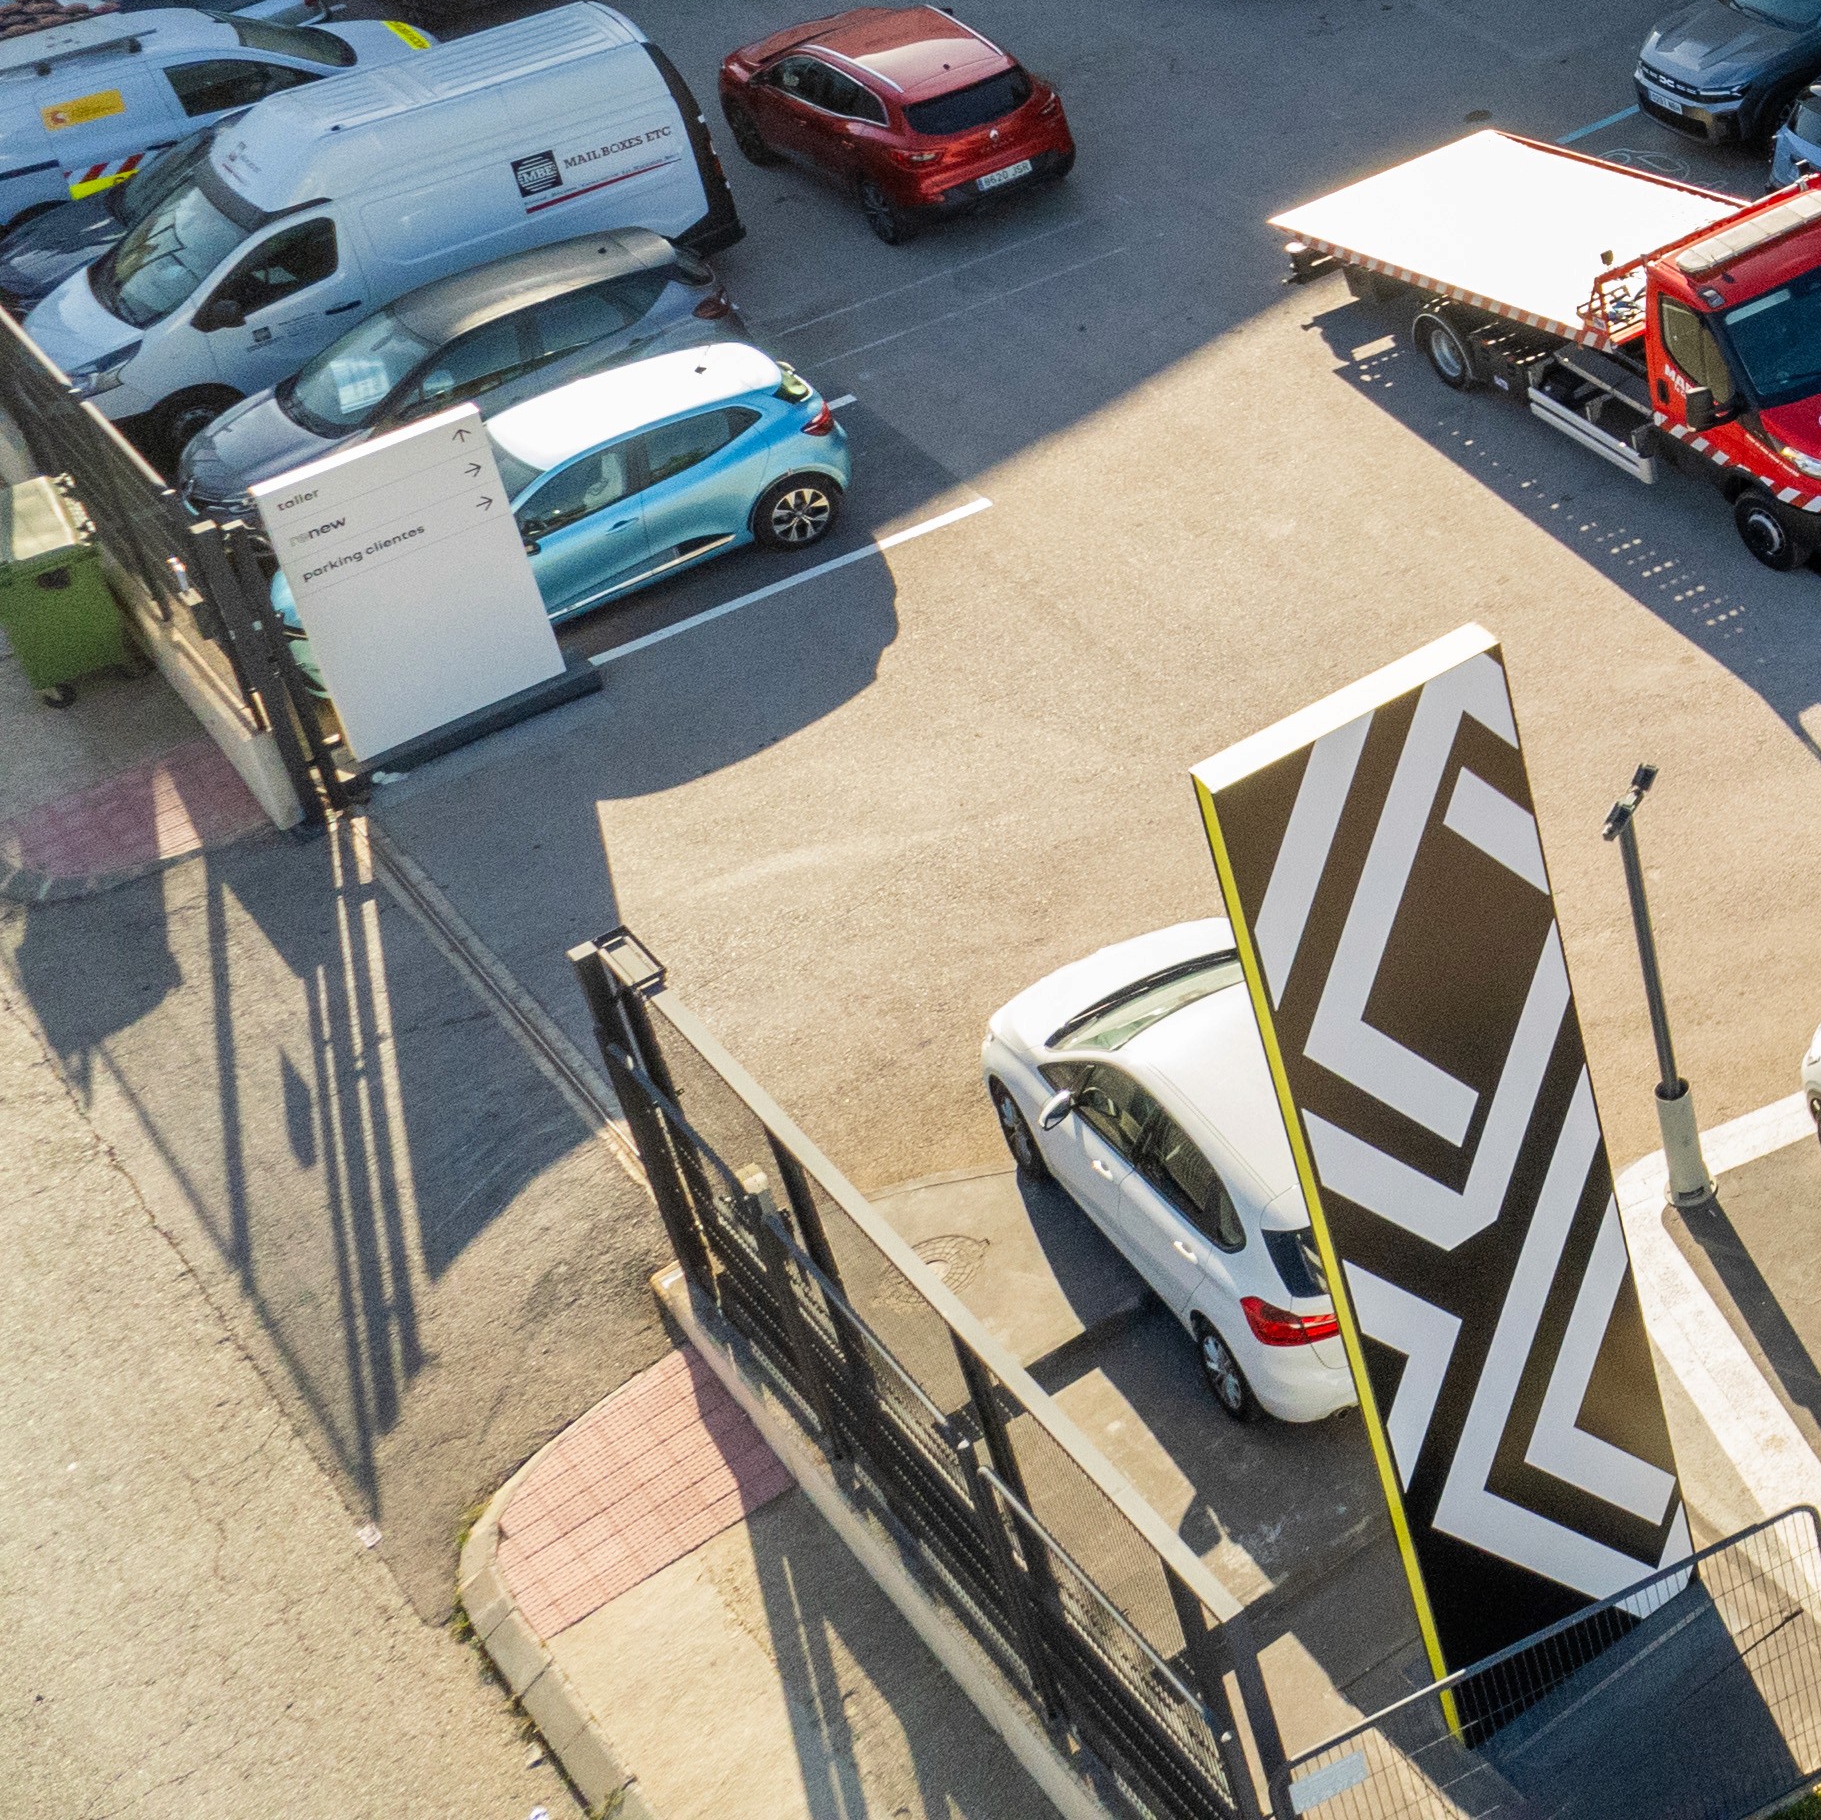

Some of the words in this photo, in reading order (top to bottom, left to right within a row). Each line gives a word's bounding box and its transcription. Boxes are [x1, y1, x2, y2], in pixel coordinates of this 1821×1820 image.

[646, 126, 671, 142] ETC
[277, 489, 319, 512] taller
[303, 547, 364, 582] parking
[366, 524, 426, 555] clientes
